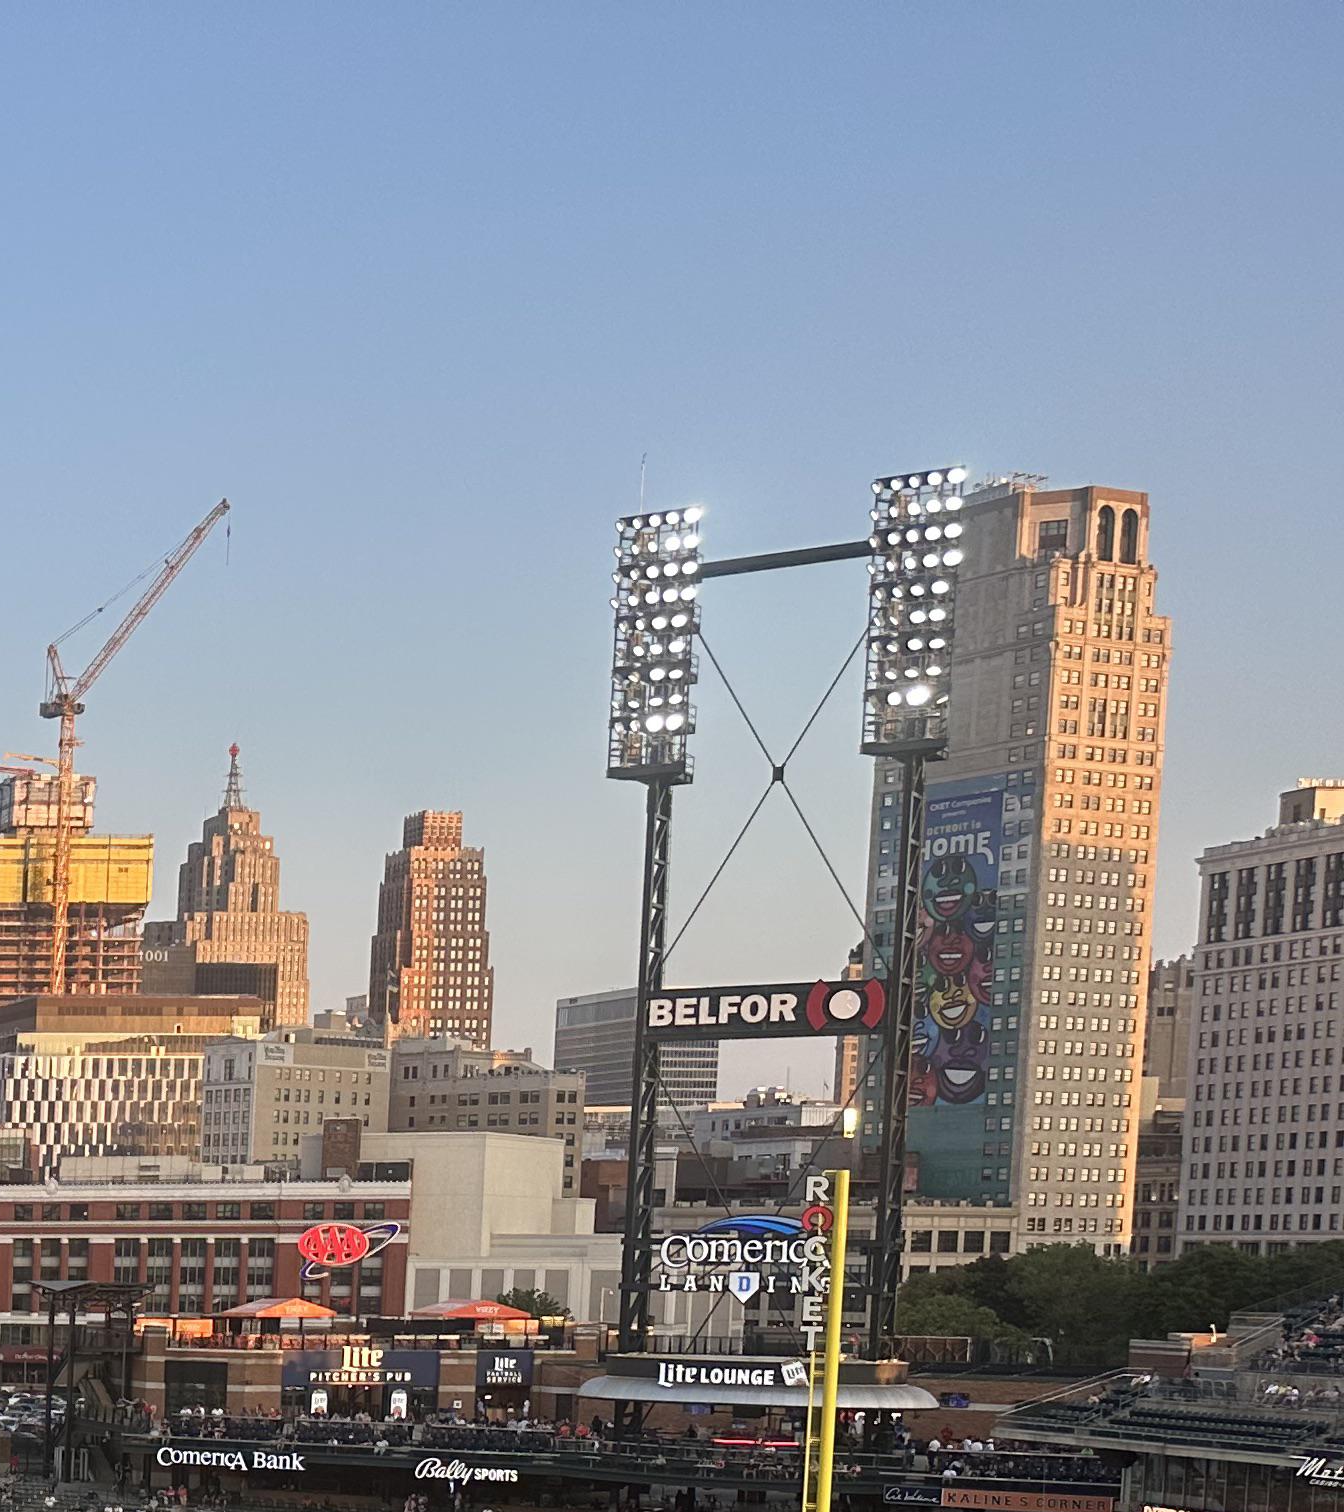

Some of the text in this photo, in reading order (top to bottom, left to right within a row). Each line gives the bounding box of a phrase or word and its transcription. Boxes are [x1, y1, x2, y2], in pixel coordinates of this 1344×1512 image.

[927, 822, 969, 836] DETROIT
[649, 993, 798, 1027] BELFOR
[801, 1176, 833, 1351] ROCKET
[342, 1346, 384, 1371] Lite
[495, 1357, 516, 1370] Lite
[310, 1371, 412, 1382] PITCHER'S PUB
[657, 1362, 774, 1388] Lite LOUNGE
[157, 1447, 306, 1471] Comerica Bank
[415, 1457, 518, 1485] Bally SPORTS
[1036, 1497, 1105, 1511] CORNER
